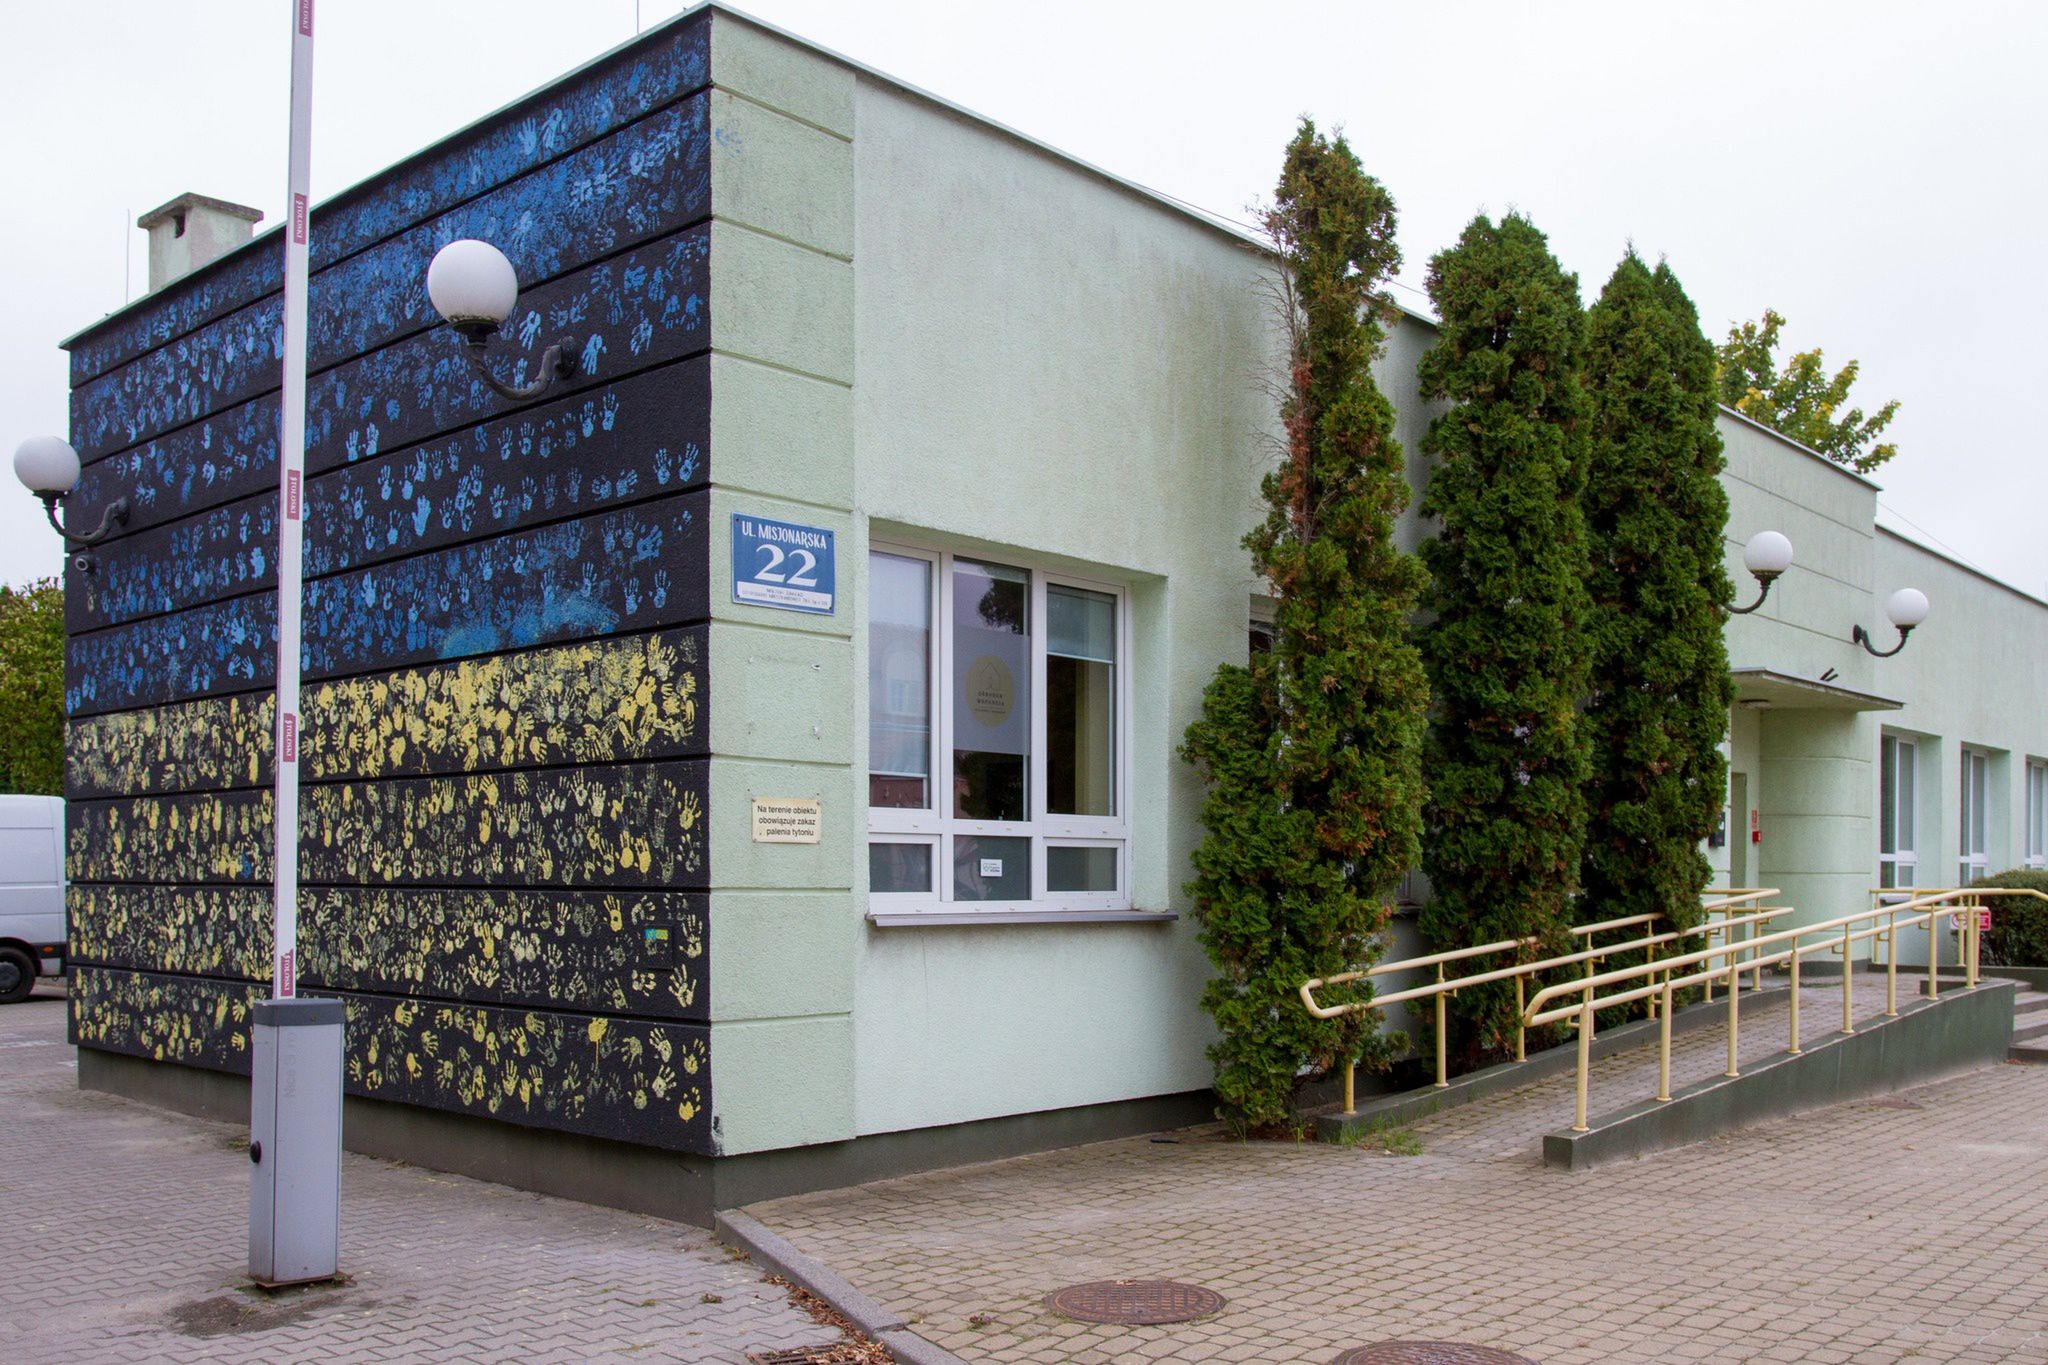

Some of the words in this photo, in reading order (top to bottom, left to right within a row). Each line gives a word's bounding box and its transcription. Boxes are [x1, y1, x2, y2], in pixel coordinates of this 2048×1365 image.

[742, 521, 756, 536] UL.
[758, 524, 827, 549] MISJONARSKA
[754, 544, 818, 587] 22
[757, 805, 767, 813] Na
[768, 806, 791, 814] terenie
[793, 807, 817, 815] obiektu
[758, 816, 796, 826] obowiązuje
[797, 817, 816, 826] zakaz
[766, 828, 791, 837] palenia
[792, 828, 814, 838] tytoniu
